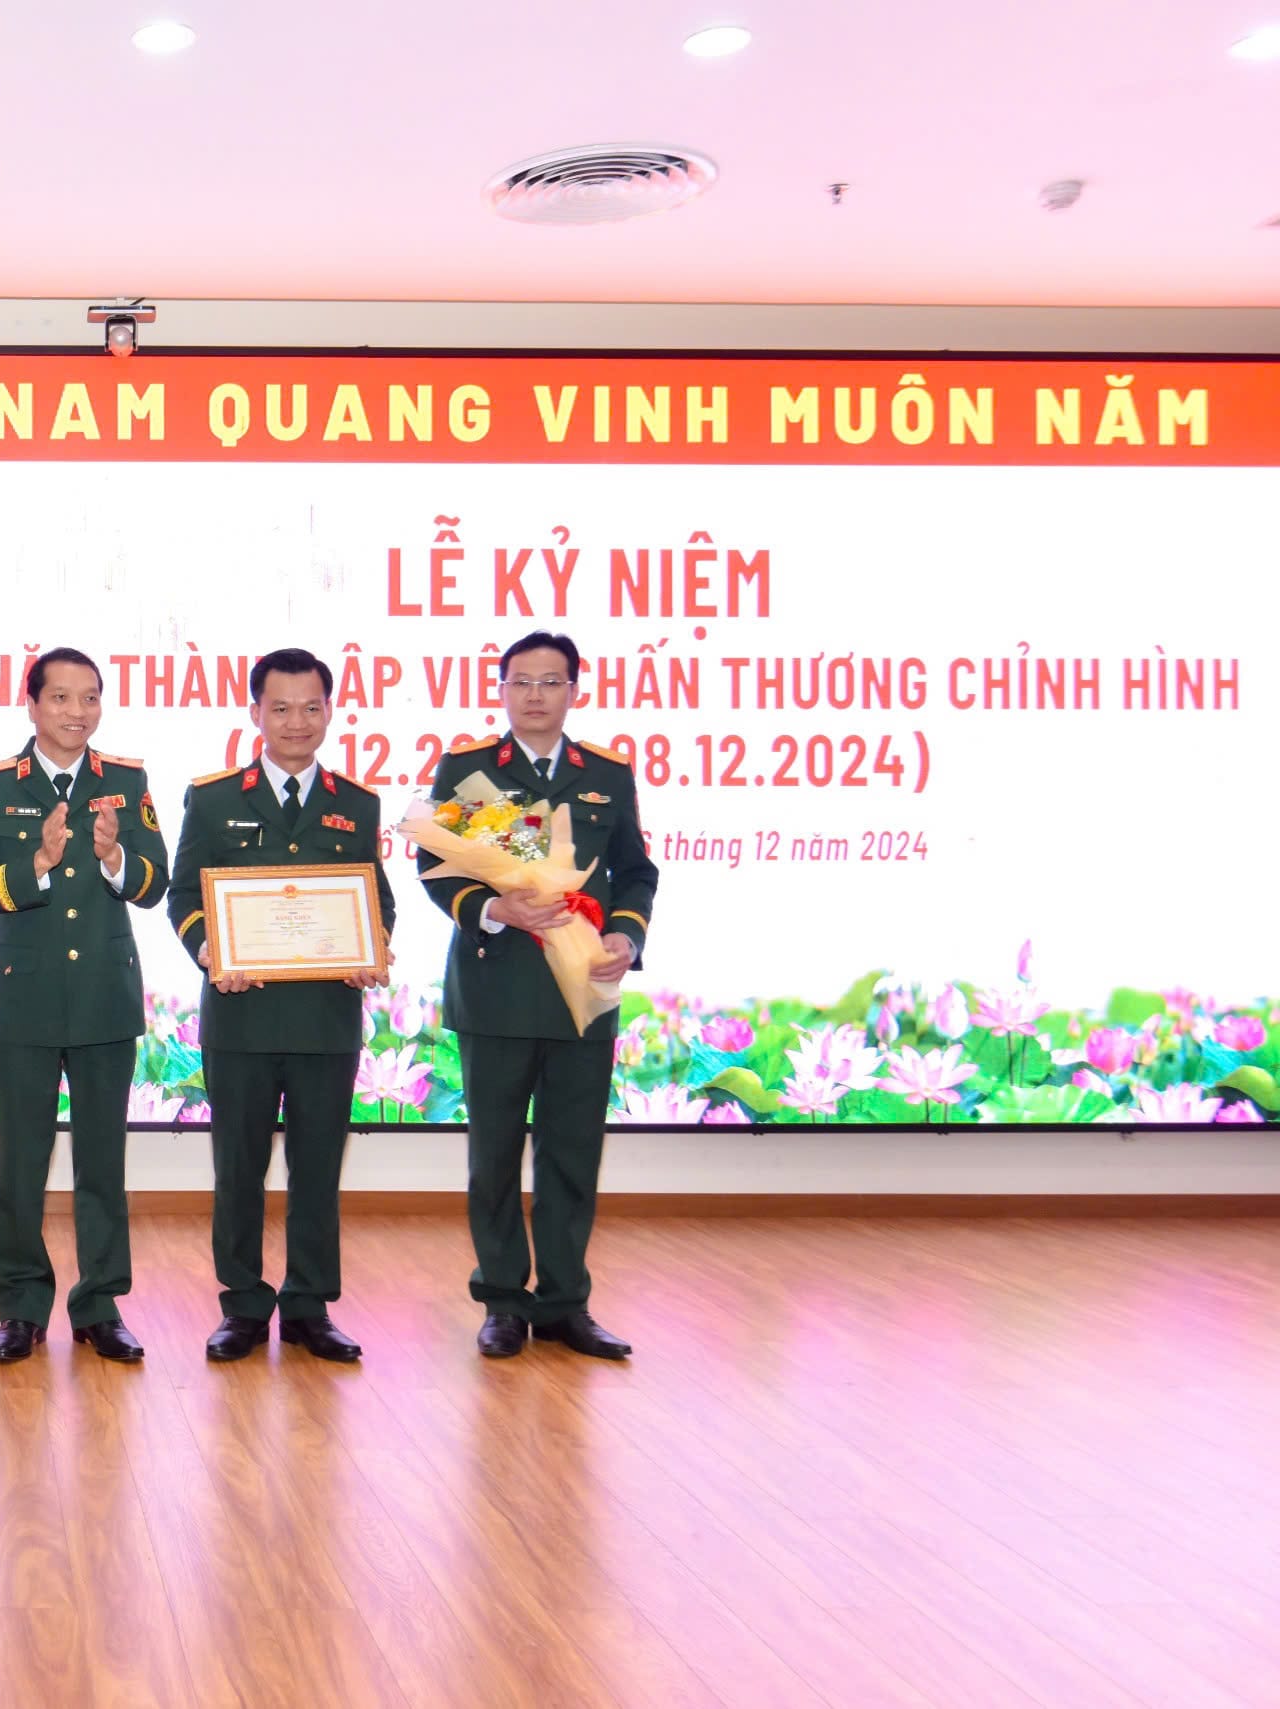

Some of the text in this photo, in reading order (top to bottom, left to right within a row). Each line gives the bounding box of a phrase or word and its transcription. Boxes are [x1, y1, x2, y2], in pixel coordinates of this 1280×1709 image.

[208, 382, 491, 448] QUANG
[533, 385, 728, 444] VINH
[770, 373, 994, 445] MUÔN
[1035, 374, 1209, 446] NĂM
[387, 514, 771, 640] LỄ KỶ NIỆM
[109, 640, 262, 709] THÀN
[336, 642, 403, 726] ẬP
[422, 642, 501, 726] VIỆ
[720, 651, 929, 711] THƯƠNG
[948, 639, 1102, 711] CHỈNH
[1122, 644, 1240, 711] HÌNH
[663, 830, 743, 869] tháng
[755, 831, 780, 861] 12
[791, 831, 849, 861] năm
[860, 831, 928, 862] 2024
